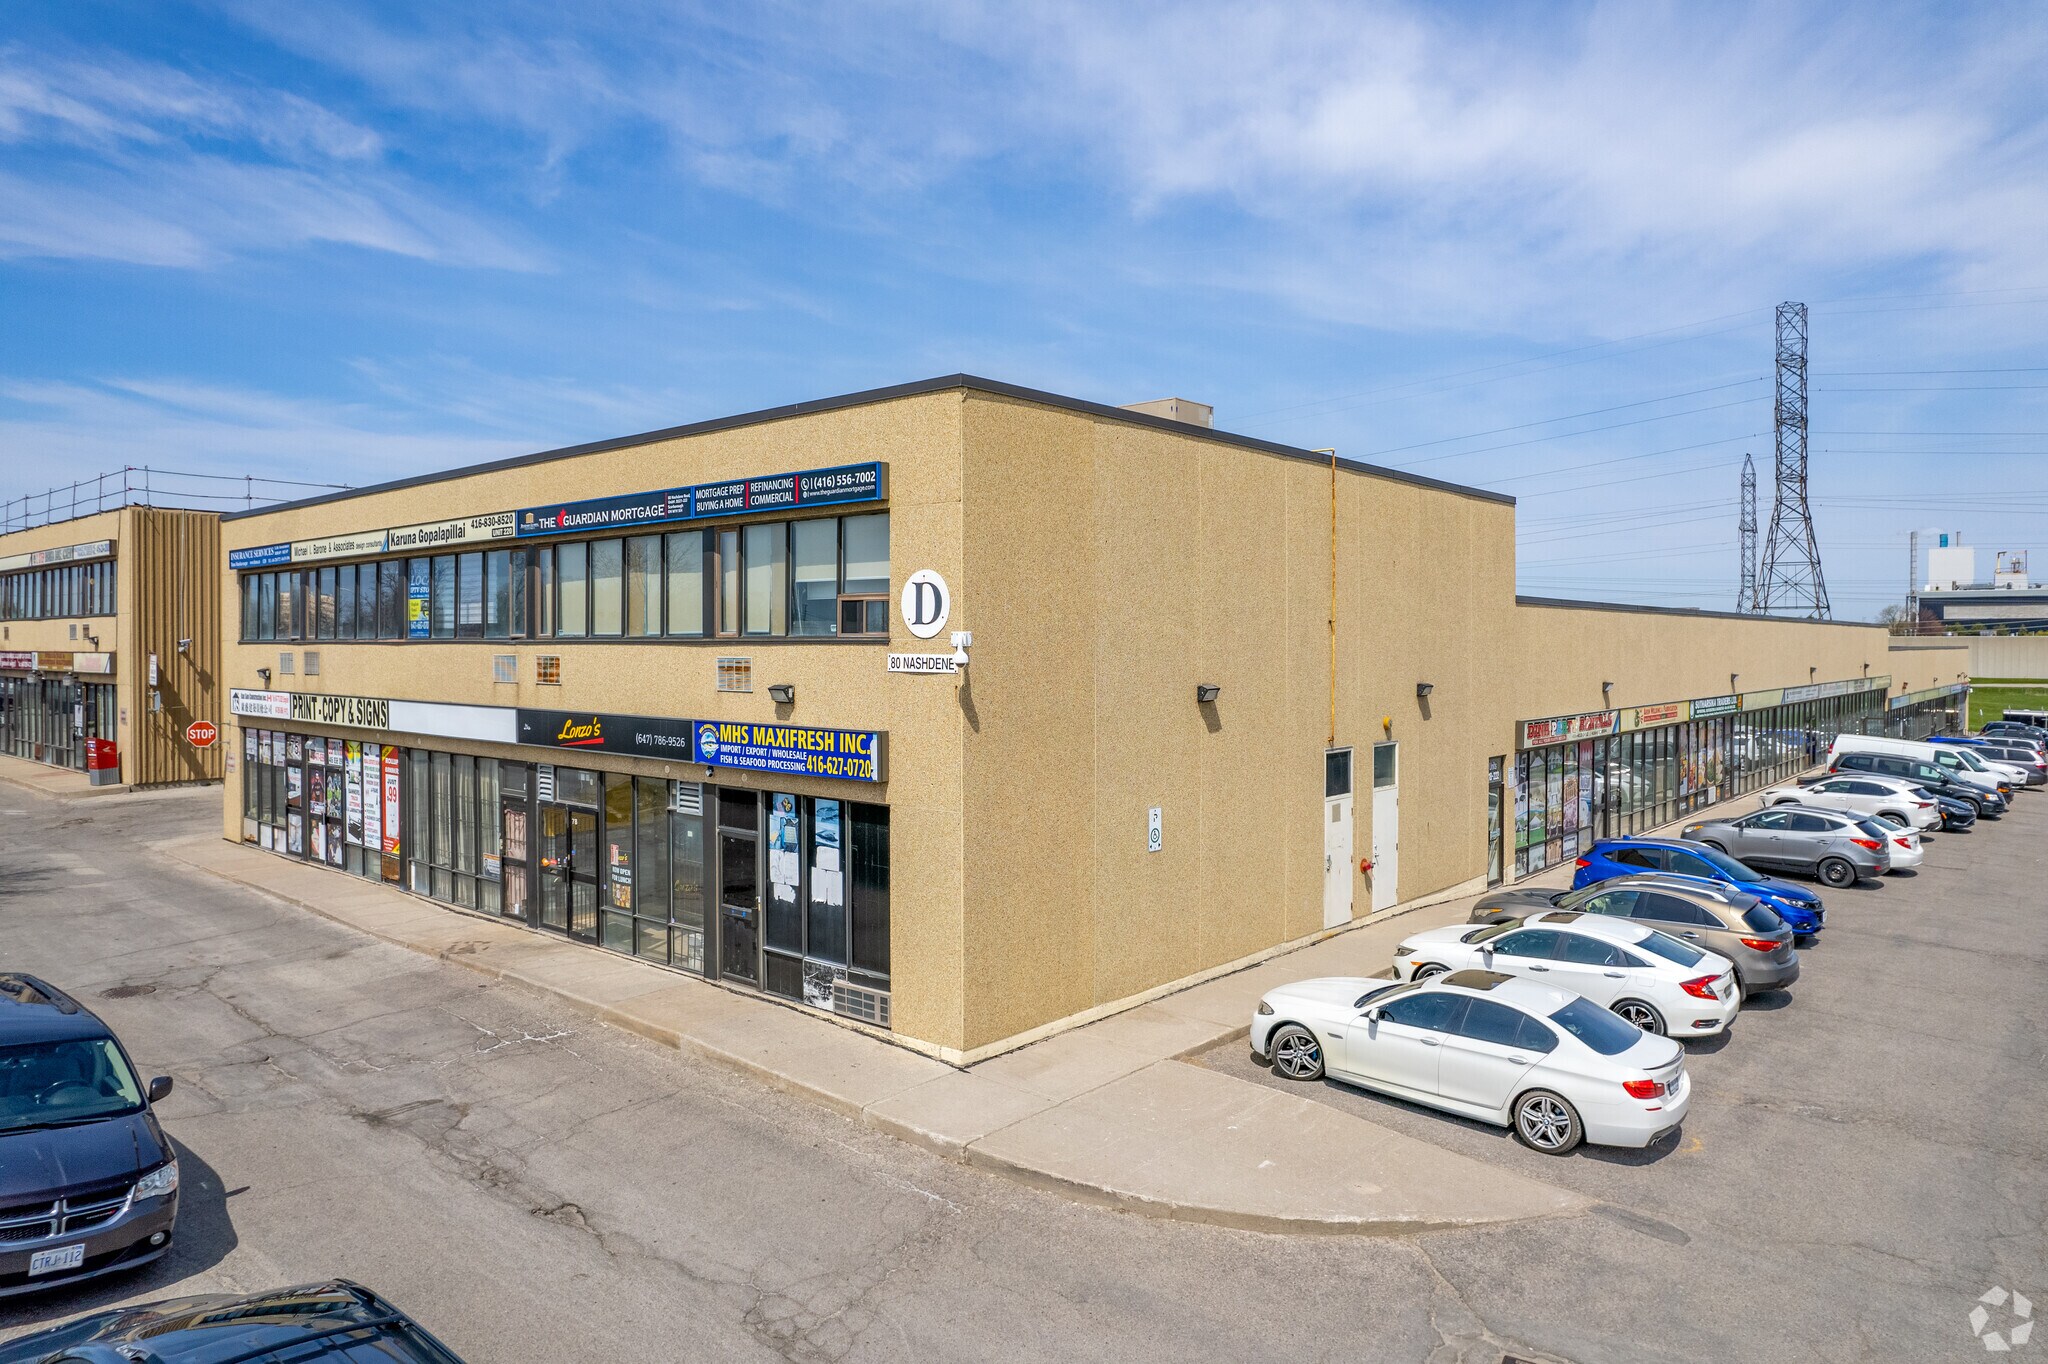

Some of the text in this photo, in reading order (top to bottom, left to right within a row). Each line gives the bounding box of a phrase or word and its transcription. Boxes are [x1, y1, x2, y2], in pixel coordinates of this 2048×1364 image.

[750, 478, 794, 492] REFINANCING
[814, 471, 876, 489] (416) 556-7002
[696, 484, 744, 499] MORTGAGE PREP
[750, 491, 794, 505] COMMERCIAL
[696, 497, 743, 512] BUYING A HOME
[471, 514, 513, 529] 416-830-8520
[539, 517, 556, 528] THE
[562, 509, 609, 526] GUARDIAN
[611, 504, 665, 522] MORTGAGE
[390, 523, 465, 546] Karuna Gopalapillai
[230, 547, 274, 560] INSURANCE SERVICES
[333, 540, 355, 552] Associates
[912, 582, 942, 625] D
[890, 657, 954, 670] 80 NASHDENE
[292, 695, 317, 720] PRINT
[322, 697, 346, 723] COPY
[348, 698, 354, 724] &
[357, 699, 387, 728] SIGNS
[189, 728, 215, 739] STOP
[558, 717, 601, 740] Lonzo's
[636, 733, 685, 748] (647) 786-9526
[720, 724, 749, 745] MHS
[753, 726, 834, 752] MAXIFRESH
[840, 734, 871, 755] INC.
[720, 744, 741, 754] IMPORT
[746, 747, 767, 757] EXPORT
[772, 749, 807, 760] WHOLESALE
[720, 755, 805, 772] FISH & SEAFOOD PROCESSING
[806, 755, 871, 778] 416-627-0720
